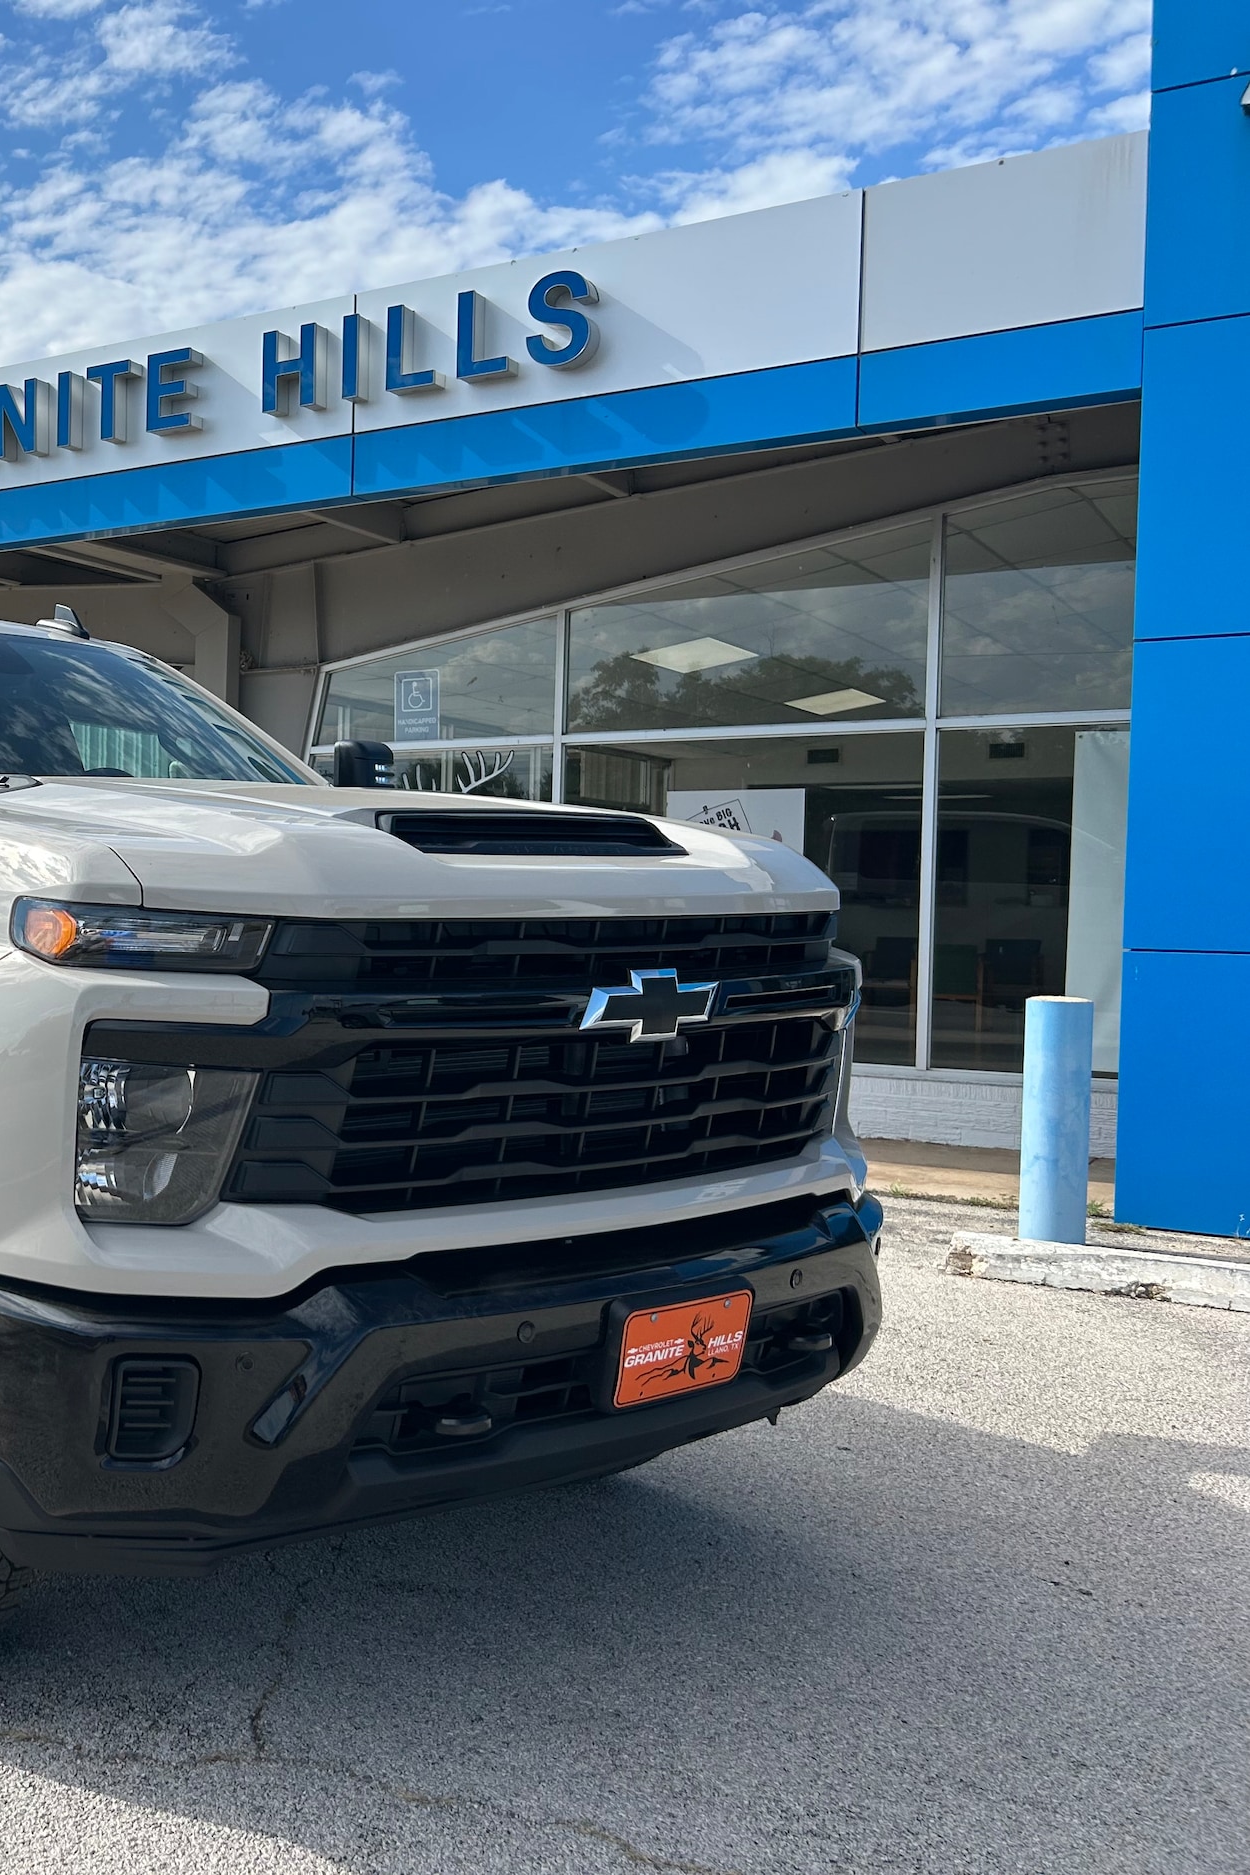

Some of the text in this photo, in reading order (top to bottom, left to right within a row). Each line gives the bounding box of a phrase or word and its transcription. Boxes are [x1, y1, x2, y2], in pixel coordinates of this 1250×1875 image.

[261, 270, 600, 417] HILLS
[397, 717, 437, 726] HANDICAPPED
[405, 726, 430, 734] PARKING
[716, 808, 732, 821] BIG
[624, 1331, 744, 1368] GRANITE HILLS
[638, 1339, 674, 1353] CHEVROLET
[731, 1343, 739, 1351] TX
